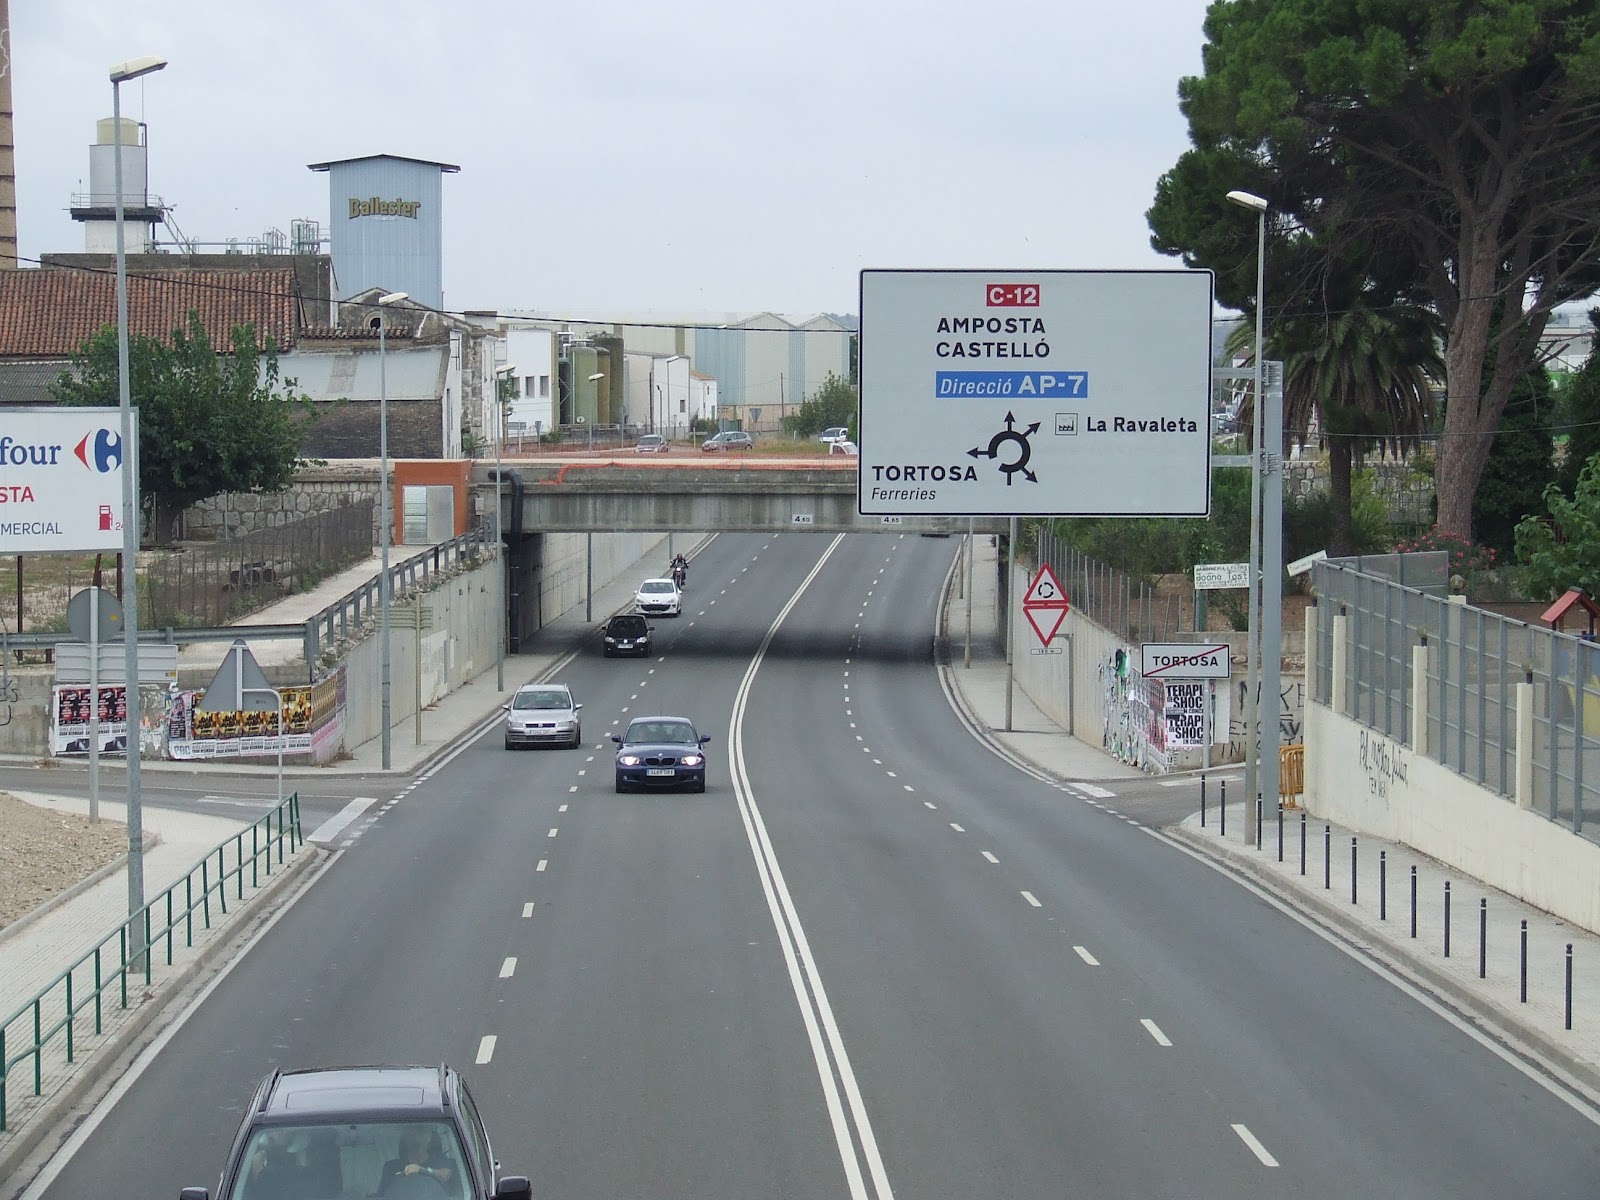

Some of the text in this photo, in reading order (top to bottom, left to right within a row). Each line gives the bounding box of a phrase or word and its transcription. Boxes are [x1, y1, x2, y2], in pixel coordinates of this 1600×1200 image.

[348, 197, 421, 219] Ballester
[989, 287, 1037, 304] C-12
[937, 317, 1046, 333] AMPOSTA
[936, 339, 1050, 358] CASTELLÓ
[940, 376, 1085, 395] Direcció AP-7
[1087, 417, 1197, 432] La Ravaleta
[872, 466, 978, 481] TORTOSA
[872, 488, 936, 500] Ferreries
[1, 522, 63, 536] MERCIAL
[1153, 656, 1218, 667] TORTOSA
[1166, 684, 1203, 697] TERAPI
[1173, 696, 1203, 708] SHOC
[1175, 727, 1204, 739] SHOC
